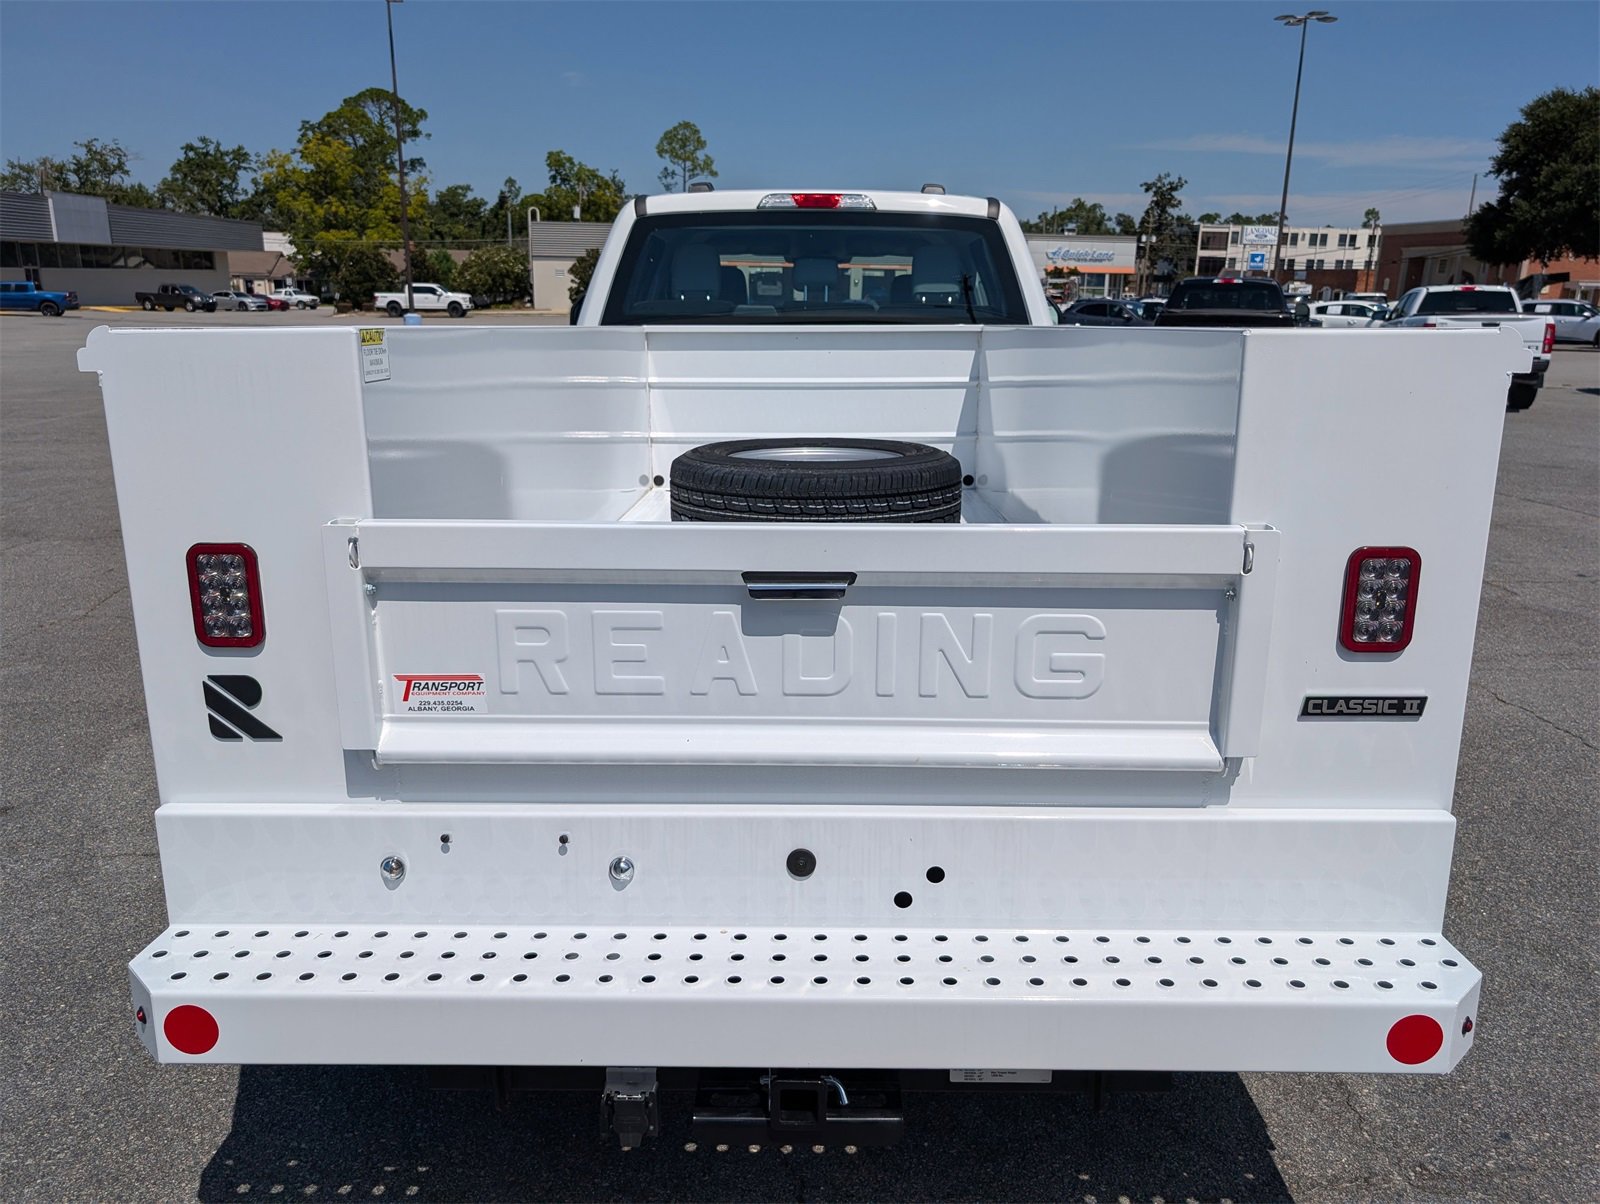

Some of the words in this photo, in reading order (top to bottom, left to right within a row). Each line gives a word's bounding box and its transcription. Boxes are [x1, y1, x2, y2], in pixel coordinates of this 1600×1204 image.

[493, 608, 1108, 700] READING
[393, 674, 485, 702] TRANSPORT
[1307, 699, 1398, 714] CLASSIC
[1402, 700, 1421, 714] II
